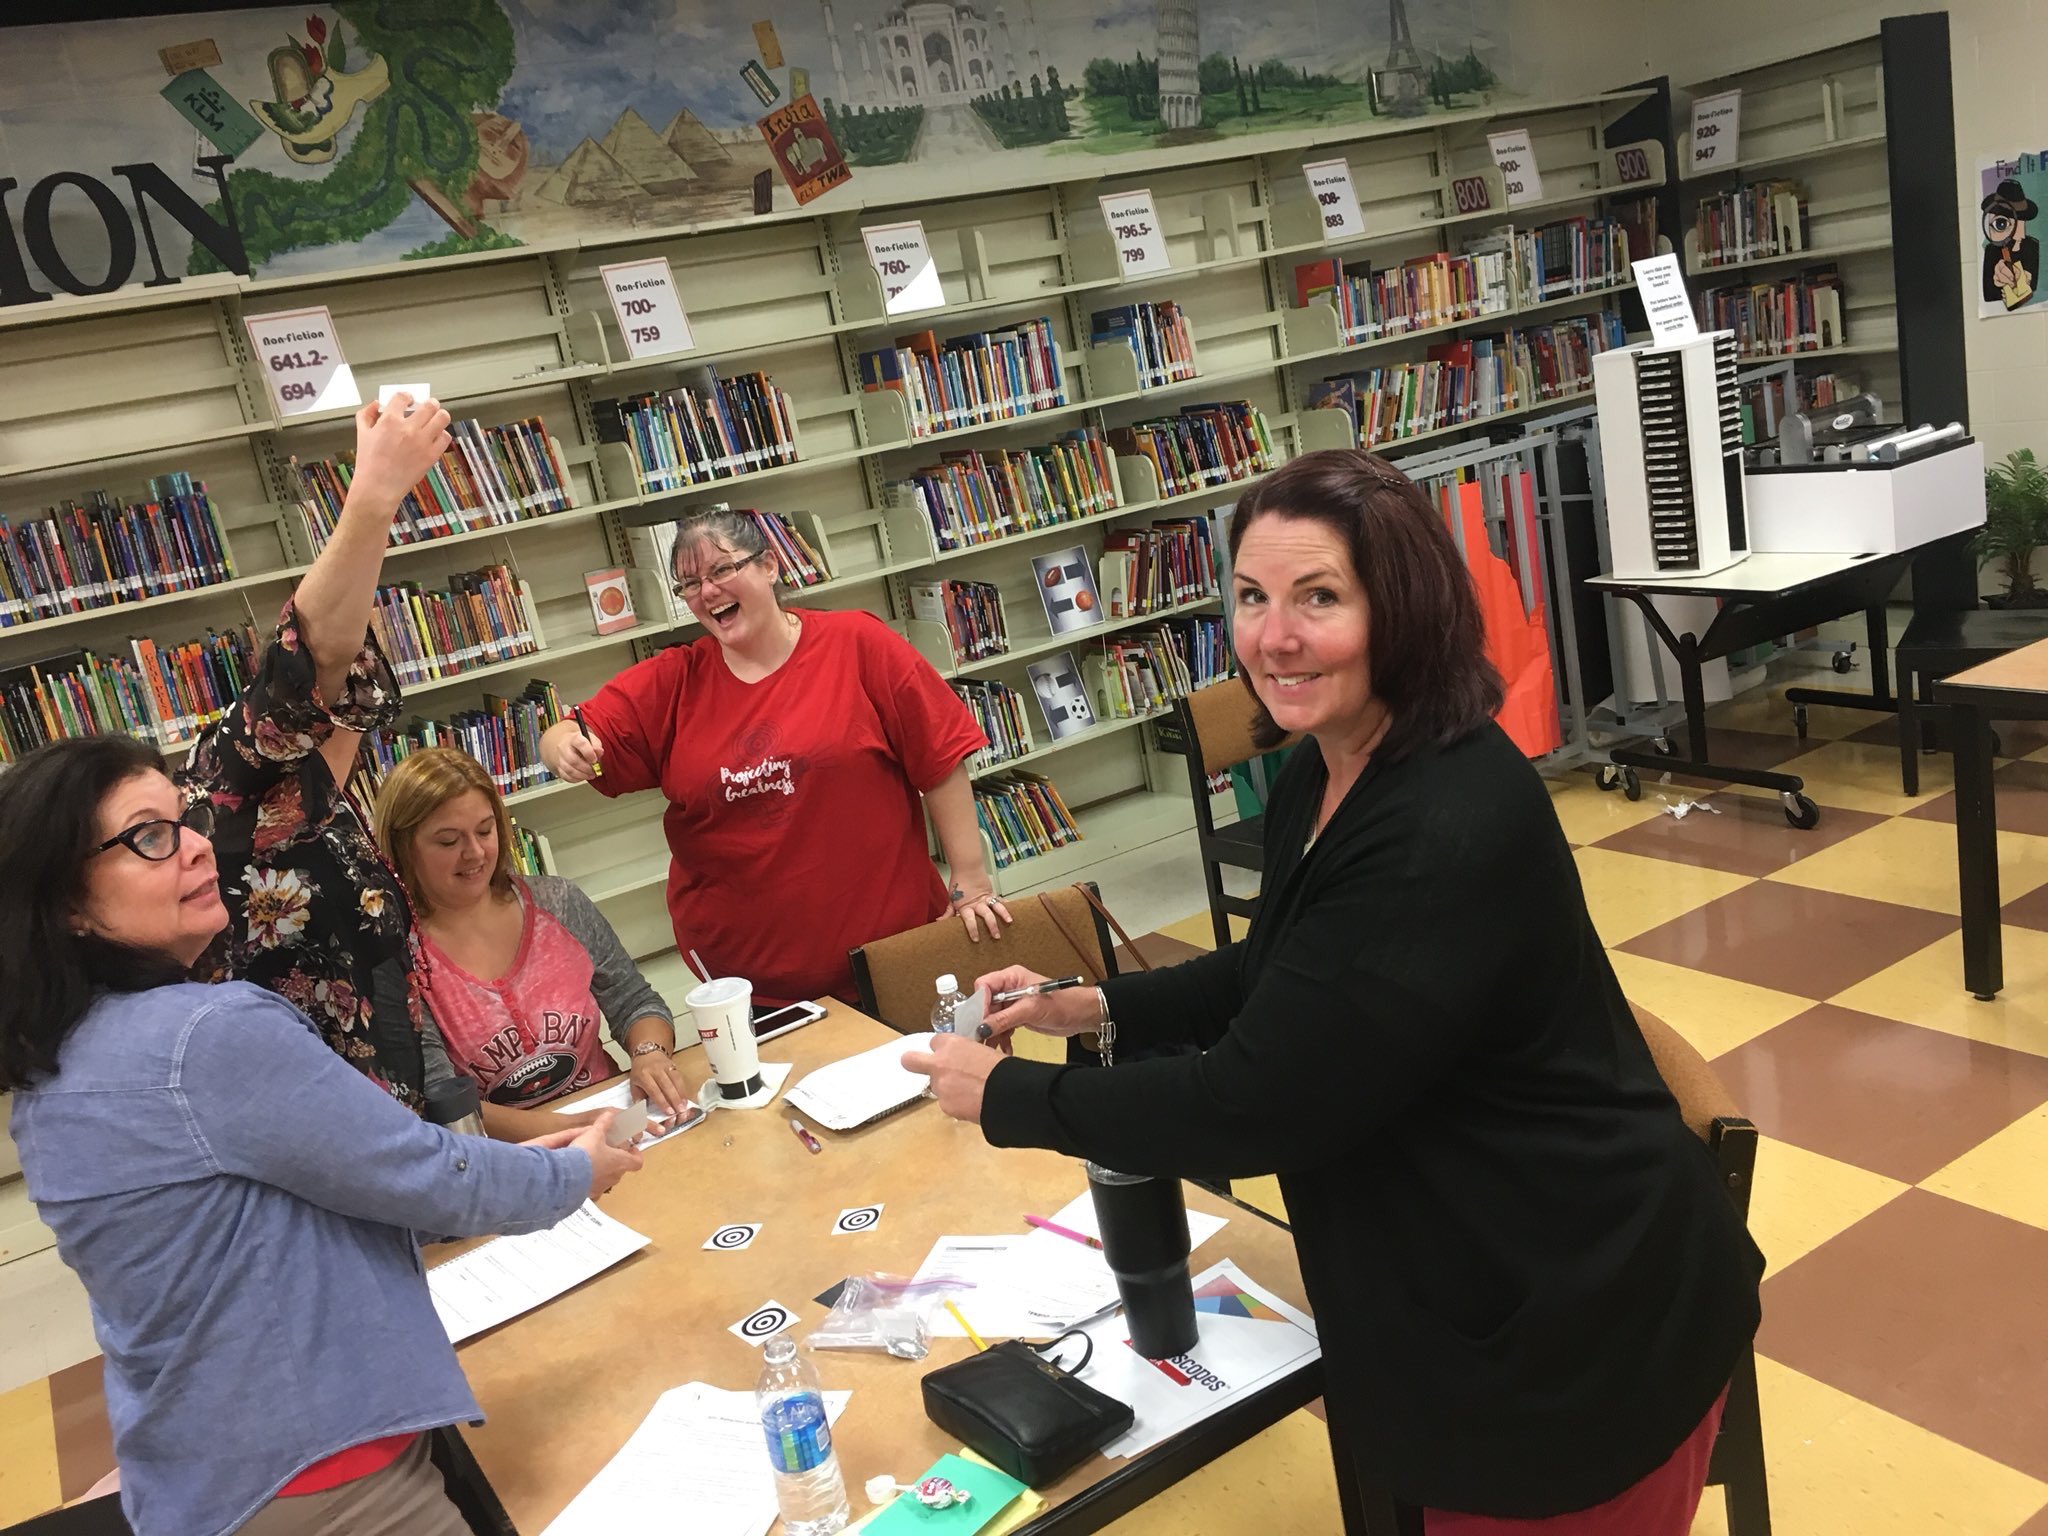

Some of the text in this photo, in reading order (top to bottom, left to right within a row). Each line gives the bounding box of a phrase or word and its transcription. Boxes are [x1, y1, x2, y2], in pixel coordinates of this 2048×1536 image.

[183, 93, 225, 133] KLM
[763, 102, 815, 142] India
[1695, 146, 1716, 161] 947
[817, 163, 848, 188] TWA
[1616, 151, 1648, 180] 900
[1996, 157, 2022, 179] Find
[1454, 178, 1487, 211] 800
[1115, 222, 1152, 240] 796.5-
[1324, 213, 1344, 228] 883
[1121, 247, 1146, 263] 799
[879, 259, 911, 276] 760-
[621, 298, 657, 317] 700-
[630, 325, 661, 344] 759
[269, 349, 329, 372] 641.2-
[280, 380, 317, 401] 694
[719, 755, 792, 787] Projecting
[725, 778, 796, 802] Greatness
[468, 1024, 540, 1092] AMP
[542, 1010, 591, 1048] BAY
[1171, 1353, 1226, 1392] scopes
